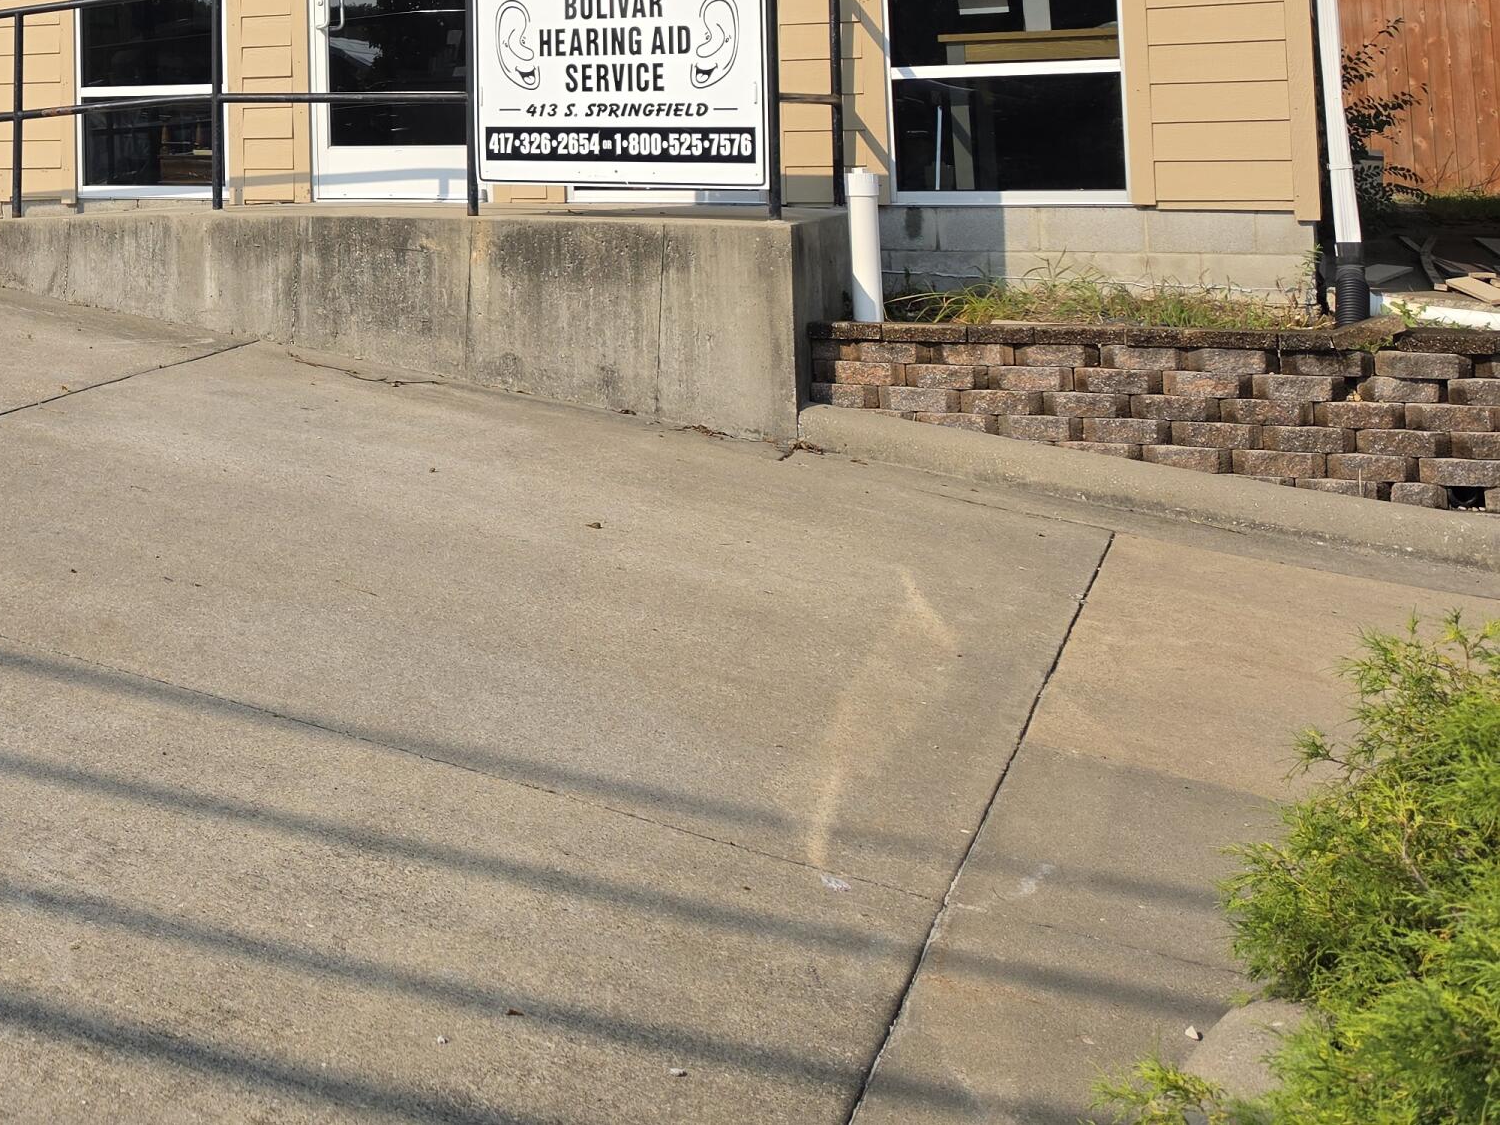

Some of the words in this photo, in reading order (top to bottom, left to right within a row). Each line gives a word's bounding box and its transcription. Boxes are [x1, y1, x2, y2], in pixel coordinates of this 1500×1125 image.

[539, 26, 643, 57] HEARING
[651, 25, 692, 55] AID
[565, 62, 665, 93] SERVICE
[525, 103, 558, 118] 413
[564, 103, 578, 118] S.
[585, 102, 710, 118] SPRINGFIELD
[602, 139, 613, 150] OR
